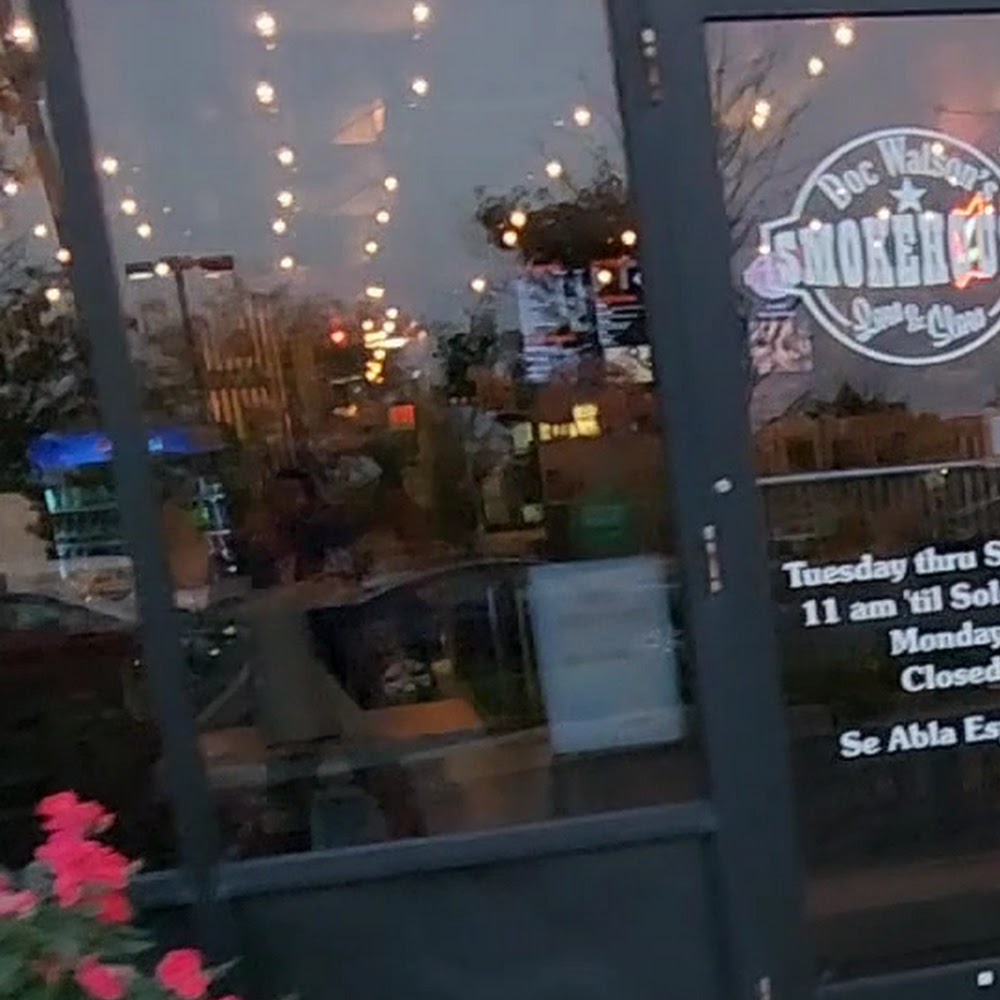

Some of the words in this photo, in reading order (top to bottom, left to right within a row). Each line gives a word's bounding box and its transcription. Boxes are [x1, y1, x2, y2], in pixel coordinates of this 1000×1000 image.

[817, 160, 880, 211] Doc
[876, 136, 999, 201] Watson's
[782, 553, 908, 588] Tuesday
[914, 547, 978, 575] thru
[801, 597, 841, 626] 11
[849, 599, 898, 622] am
[903, 586, 943, 615] 'til
[839, 730, 882, 758] Se
[887, 720, 957, 753] Abla
